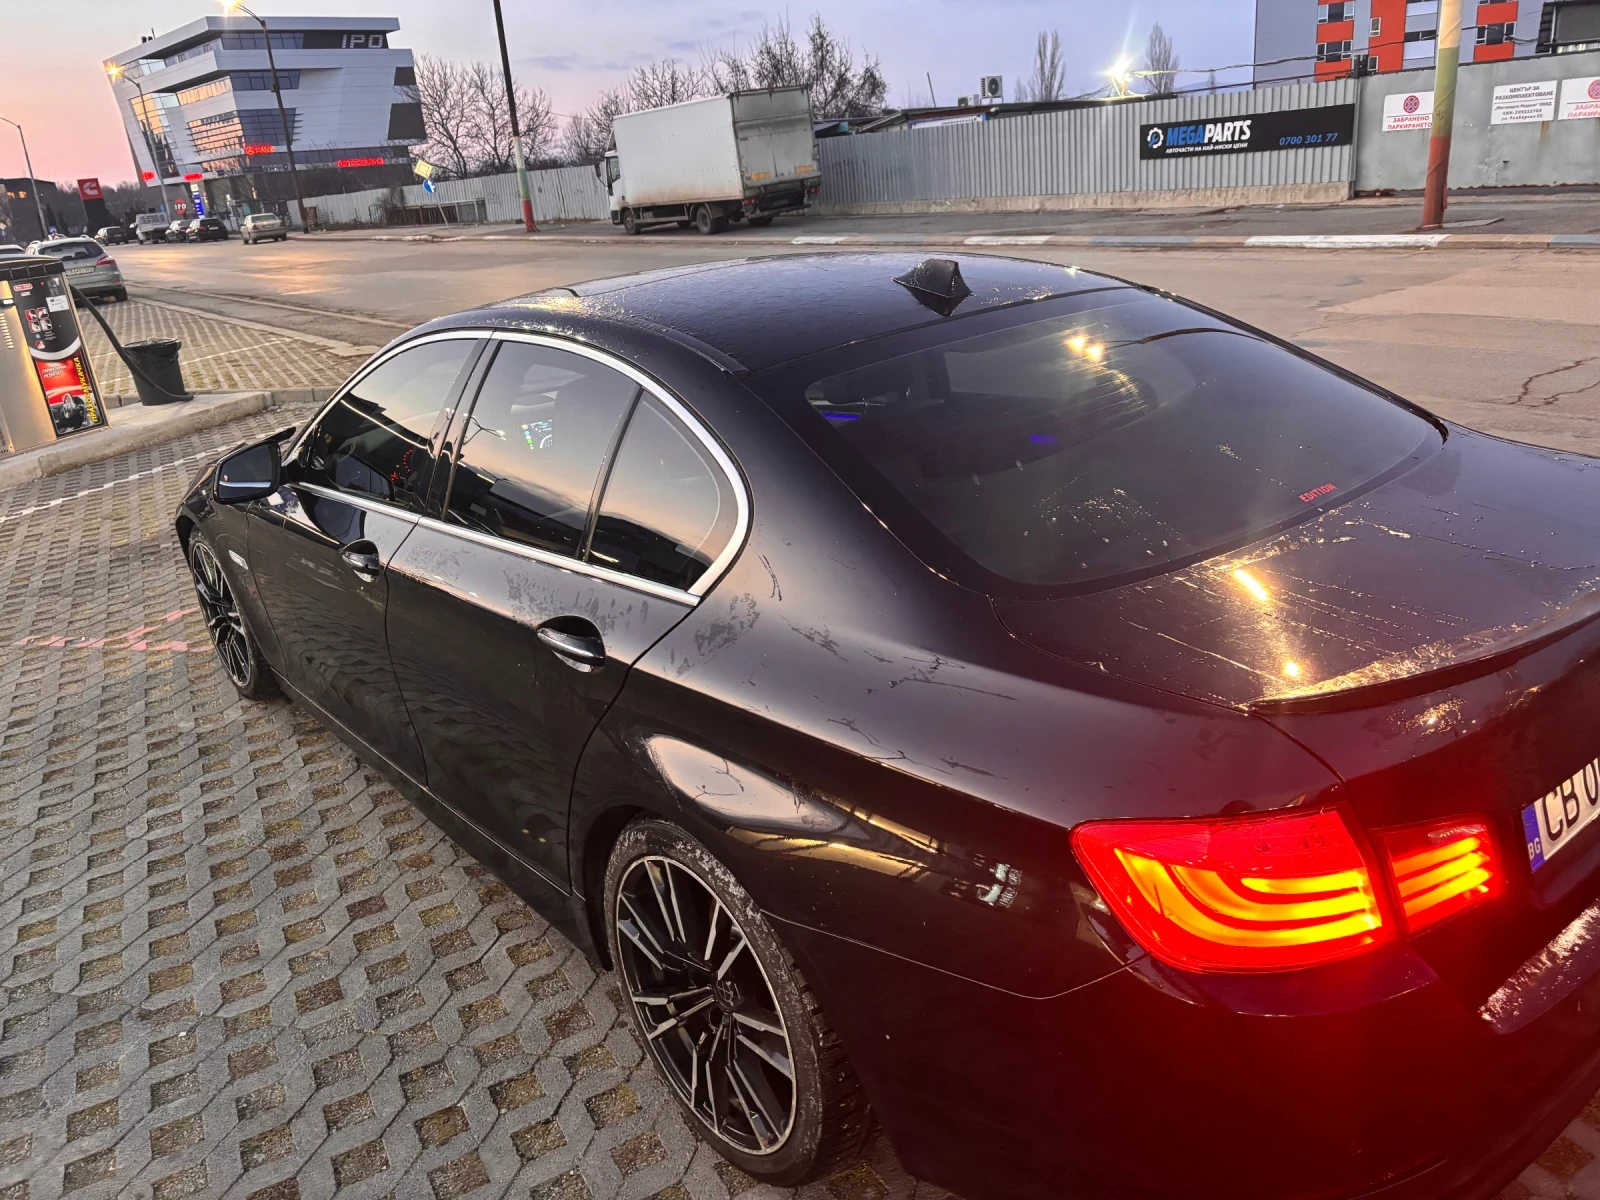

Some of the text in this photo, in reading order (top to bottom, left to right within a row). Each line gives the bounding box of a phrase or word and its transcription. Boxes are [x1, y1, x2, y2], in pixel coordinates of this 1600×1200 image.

[342, 34, 383, 48] IPO
[1495, 91, 1554, 100] РАЗКОМПЛЕКТОВАНЕ
[1392, 115, 1429, 123] ЗАБРАНЕНО
[1165, 120, 1252, 146] MEGAPARTS
[1279, 132, 1339, 146] 0700 301 77
[1202, 143, 1232, 151] НАЙ-НИСКИ
[73, 357, 99, 423] ПРАХОСМУКАЧКА
[1298, 482, 1337, 503] EDITION
[1527, 837, 1541, 860] BG
